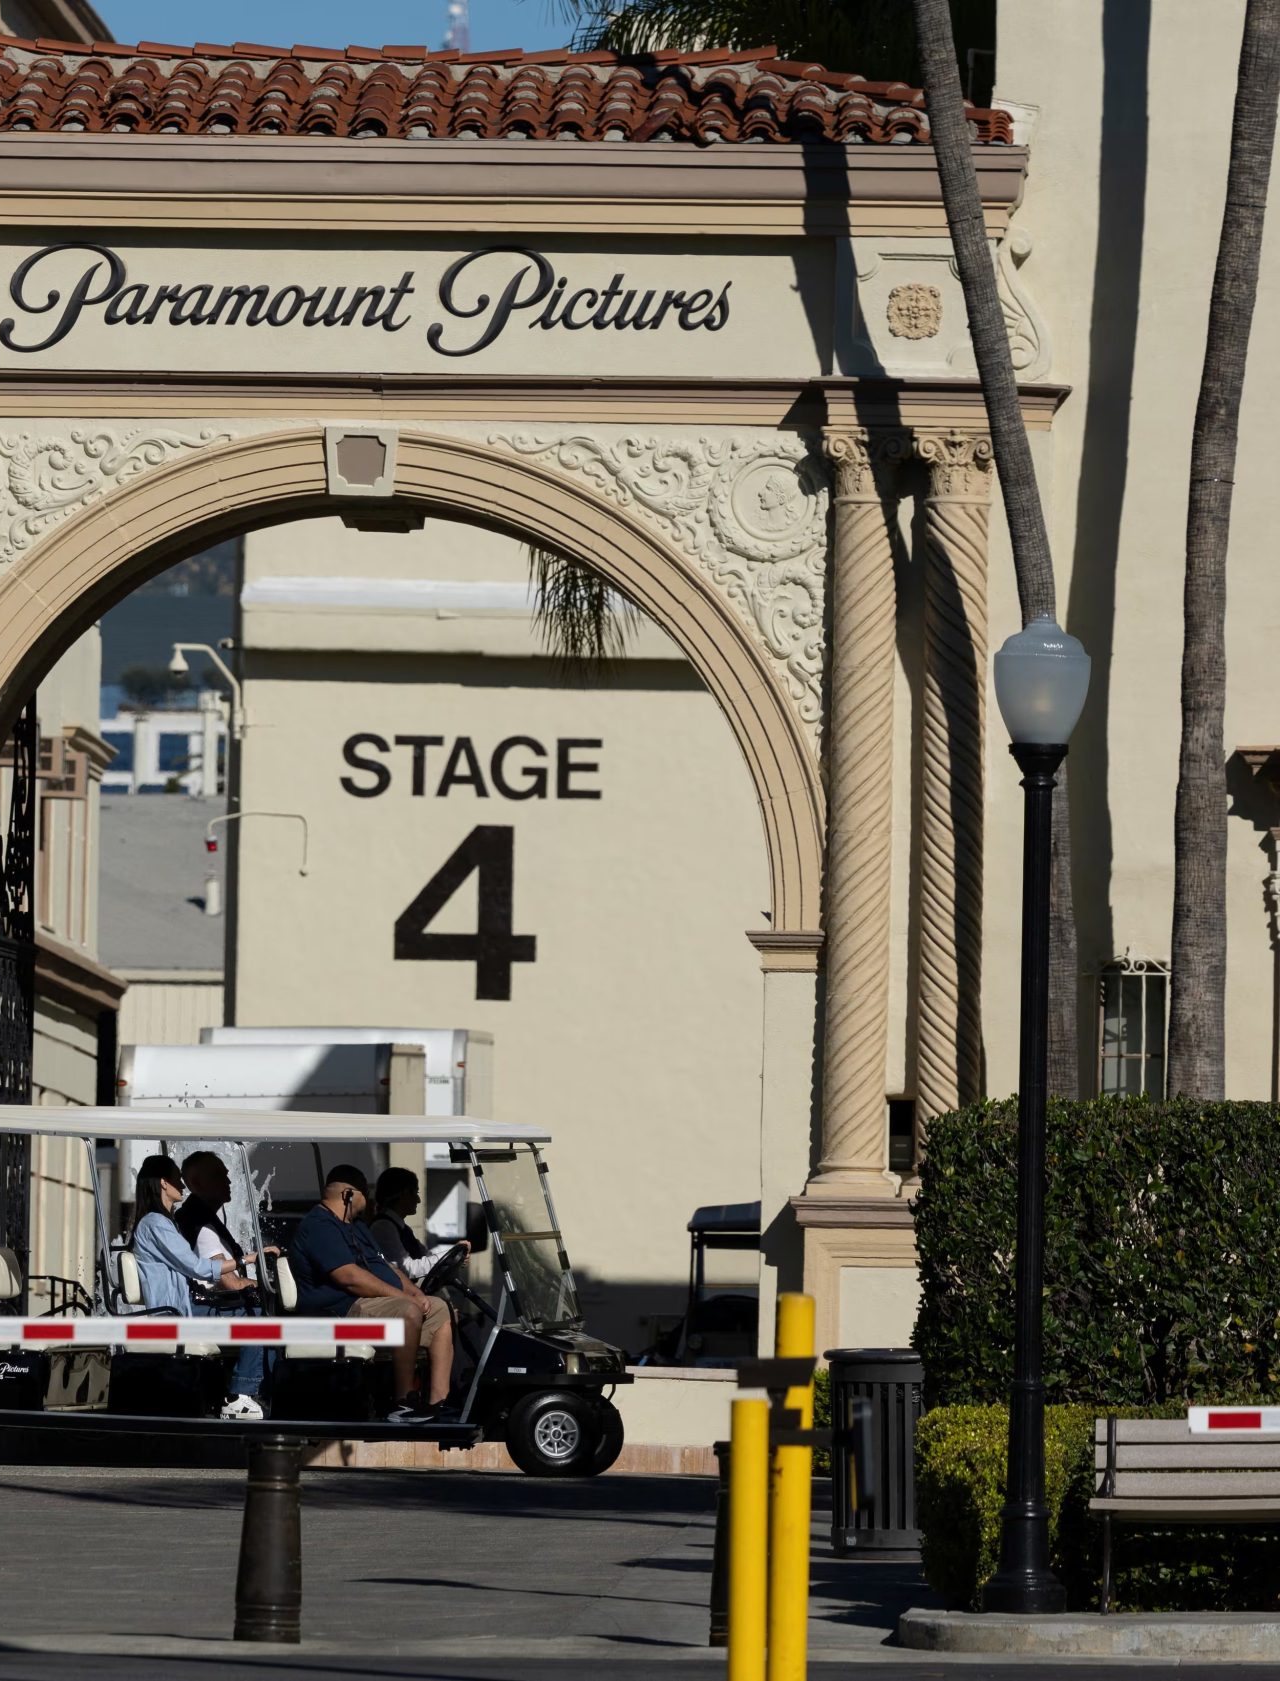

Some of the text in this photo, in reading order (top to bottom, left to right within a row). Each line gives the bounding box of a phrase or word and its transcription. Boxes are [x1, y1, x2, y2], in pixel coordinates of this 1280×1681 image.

[427, 246, 732, 357] Pictures
[340, 732, 604, 801] STAGE
[393, 824, 537, 1002] 4
